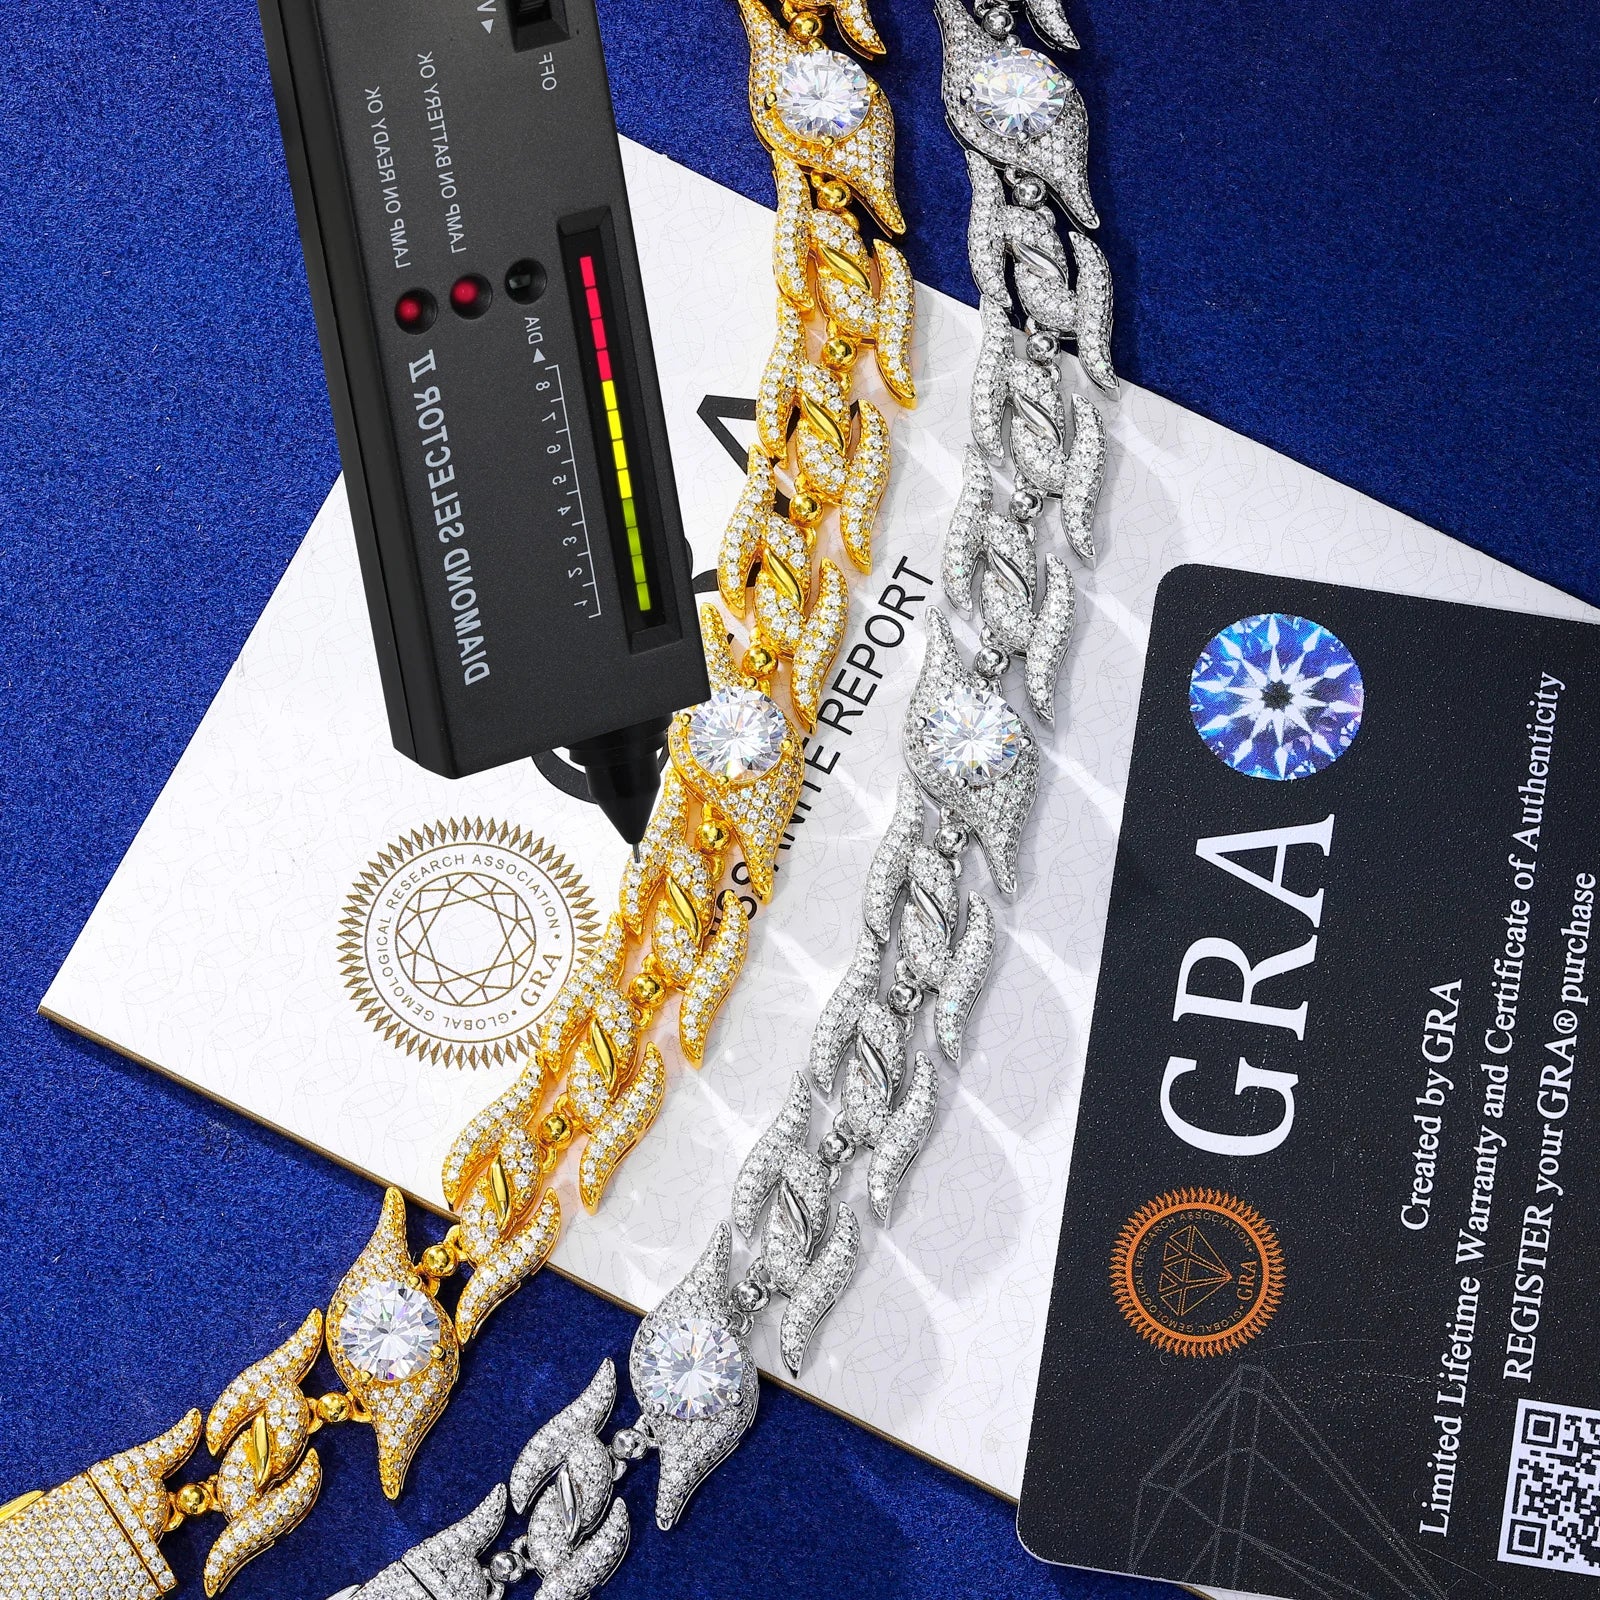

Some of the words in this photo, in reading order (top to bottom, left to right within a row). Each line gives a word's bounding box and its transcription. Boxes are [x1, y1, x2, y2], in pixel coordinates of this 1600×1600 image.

[817, 556, 934, 737] REPORT
[1513, 672, 1565, 852] Authenticity
[387, 854, 465, 910] RESEARCH
[472, 853, 561, 929] ASSOCIATION
[1508, 854, 1536, 889] of
[376, 916, 435, 1022] GEMOLOGICAL
[520, 952, 563, 1007] GRA
[1160, 814, 1334, 1156] GRA
[1485, 900, 1530, 1054] Certificate
[444, 1012, 509, 1031] GLOBAL
[1422, 979, 1461, 1063] GRA
[1416, 1068, 1454, 1105] by
[1481, 1064, 1508, 1118] and
[1503, 1204, 1553, 1382] REGISTER
[1536, 1124, 1563, 1195] your
[1561, 873, 1595, 1006] purchase
[1401, 1115, 1441, 1230] Created
[1456, 1125, 1507, 1264] Warranty
[1135, 1218, 1176, 1268] RESEARCH
[1180, 1211, 1252, 1248] ASSOCIATION
[1136, 1271, 1194, 1333] GEMOLOGICAL
[1236, 1261, 1258, 1301] GRA
[1199, 1309, 1242, 1333] GLOBAL
[1437, 1277, 1480, 1407] Lifetime
[1419, 1415, 1462, 1537] Limited
